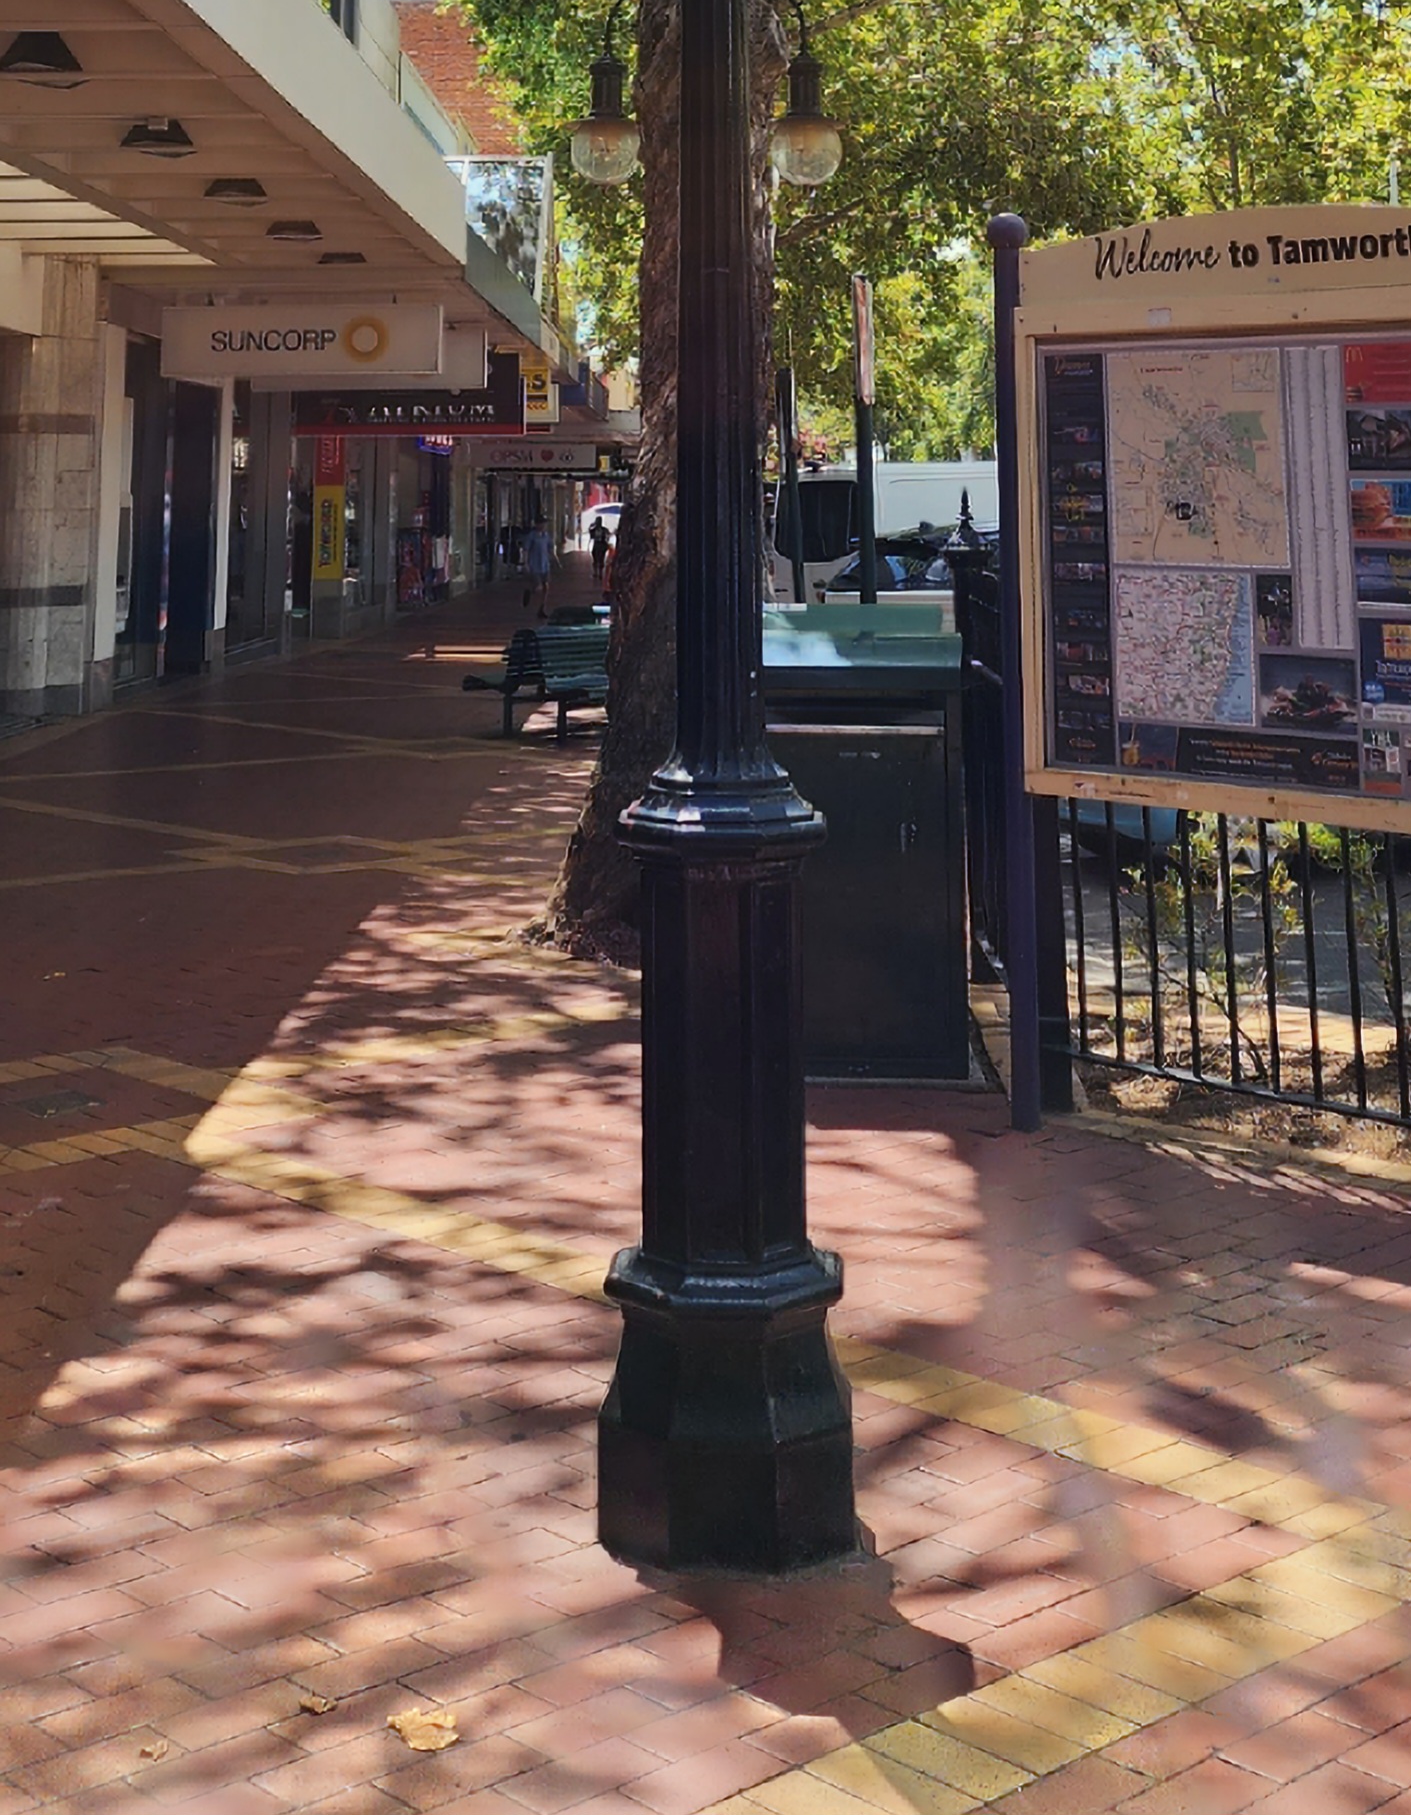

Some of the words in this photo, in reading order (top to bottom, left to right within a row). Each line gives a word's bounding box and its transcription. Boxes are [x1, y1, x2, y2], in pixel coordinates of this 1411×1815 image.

[1095, 228, 1221, 280] Welcome
[1228, 239, 1260, 268] to
[1267, 224, 1411, 266] Tamwort
[211, 329, 337, 352] SUNCORP
